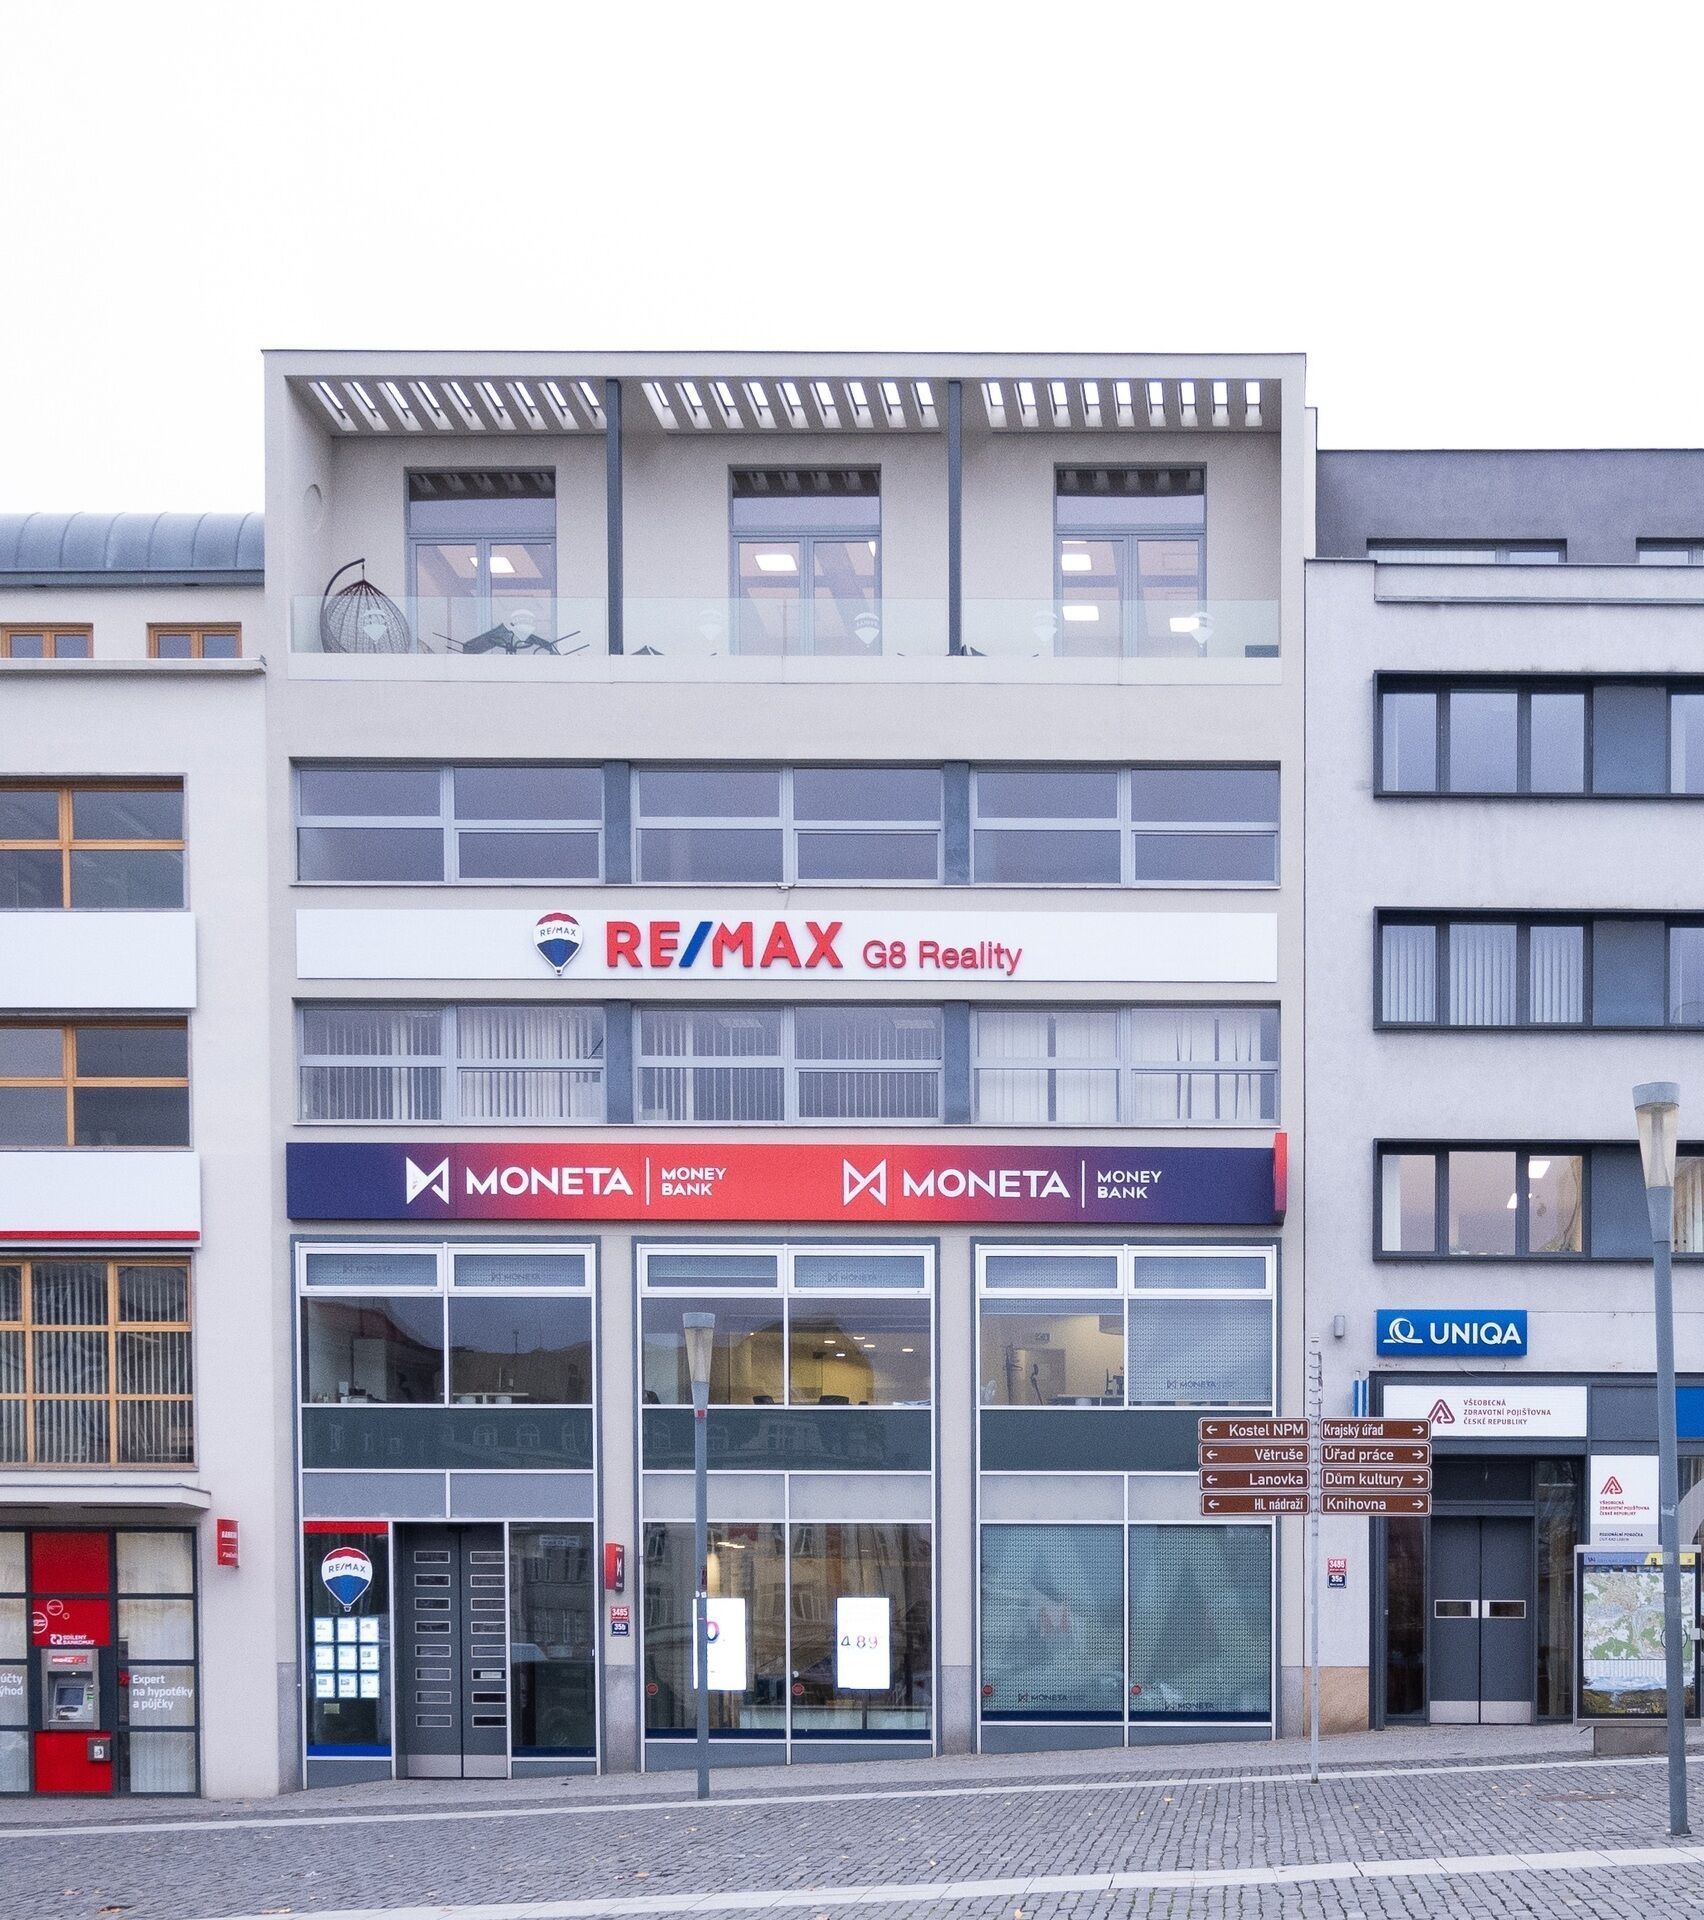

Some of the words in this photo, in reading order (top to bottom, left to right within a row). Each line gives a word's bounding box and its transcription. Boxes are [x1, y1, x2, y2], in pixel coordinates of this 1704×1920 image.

[539, 926, 577, 938] RE/MAX
[606, 921, 844, 968] RE/MAX
[862, 940, 907, 969] G8
[918, 940, 1023, 976] Reality
[661, 1166, 727, 1181] MONEY
[1096, 1170, 1162, 1183] MONEY
[466, 1166, 634, 1196] MONETA
[903, 1168, 1071, 1198] MONETA
[661, 1182, 713, 1196] BANK
[1096, 1186, 1148, 1199] BANK
[1429, 1322, 1522, 1345] UNIQA
[1463, 1398, 1507, 1406] VŠEOBECNÁ
[1463, 1408, 1505, 1416] ZDRAVOTNÍ
[1506, 1407, 1552, 1417] POJIŠŤOVNA
[1463, 1417, 1487, 1425] ČESKÉ
[1229, 1423, 1270, 1436] Kostel
[1273, 1423, 1304, 1436] NPM
[1324, 1423, 1360, 1439] Krajský
[1361, 1423, 1384, 1436] úřad
[1254, 1447, 1304, 1460] Větruše
[1325, 1446, 1356, 1460] Úřad
[1358, 1448, 1394, 1463] práce
[1249, 1473, 1304, 1486] Lanovka
[1325, 1472, 1355, 1485] Dům
[1359, 1473, 1404, 1488] kultury
[1269, 1497, 1304, 1510] nádraží
[1326, 1497, 1387, 1510] Knihovna
[328, 1562, 366, 1573] RE/MAX
[0, 1672, 23, 1686] účty
[132, 1674, 166, 1686] Expert
[132, 1688, 146, 1697] na
[147, 1686, 194, 1699] hypotéky
[132, 1700, 140, 1709] a
[141, 1698, 174, 1711] půjčky
